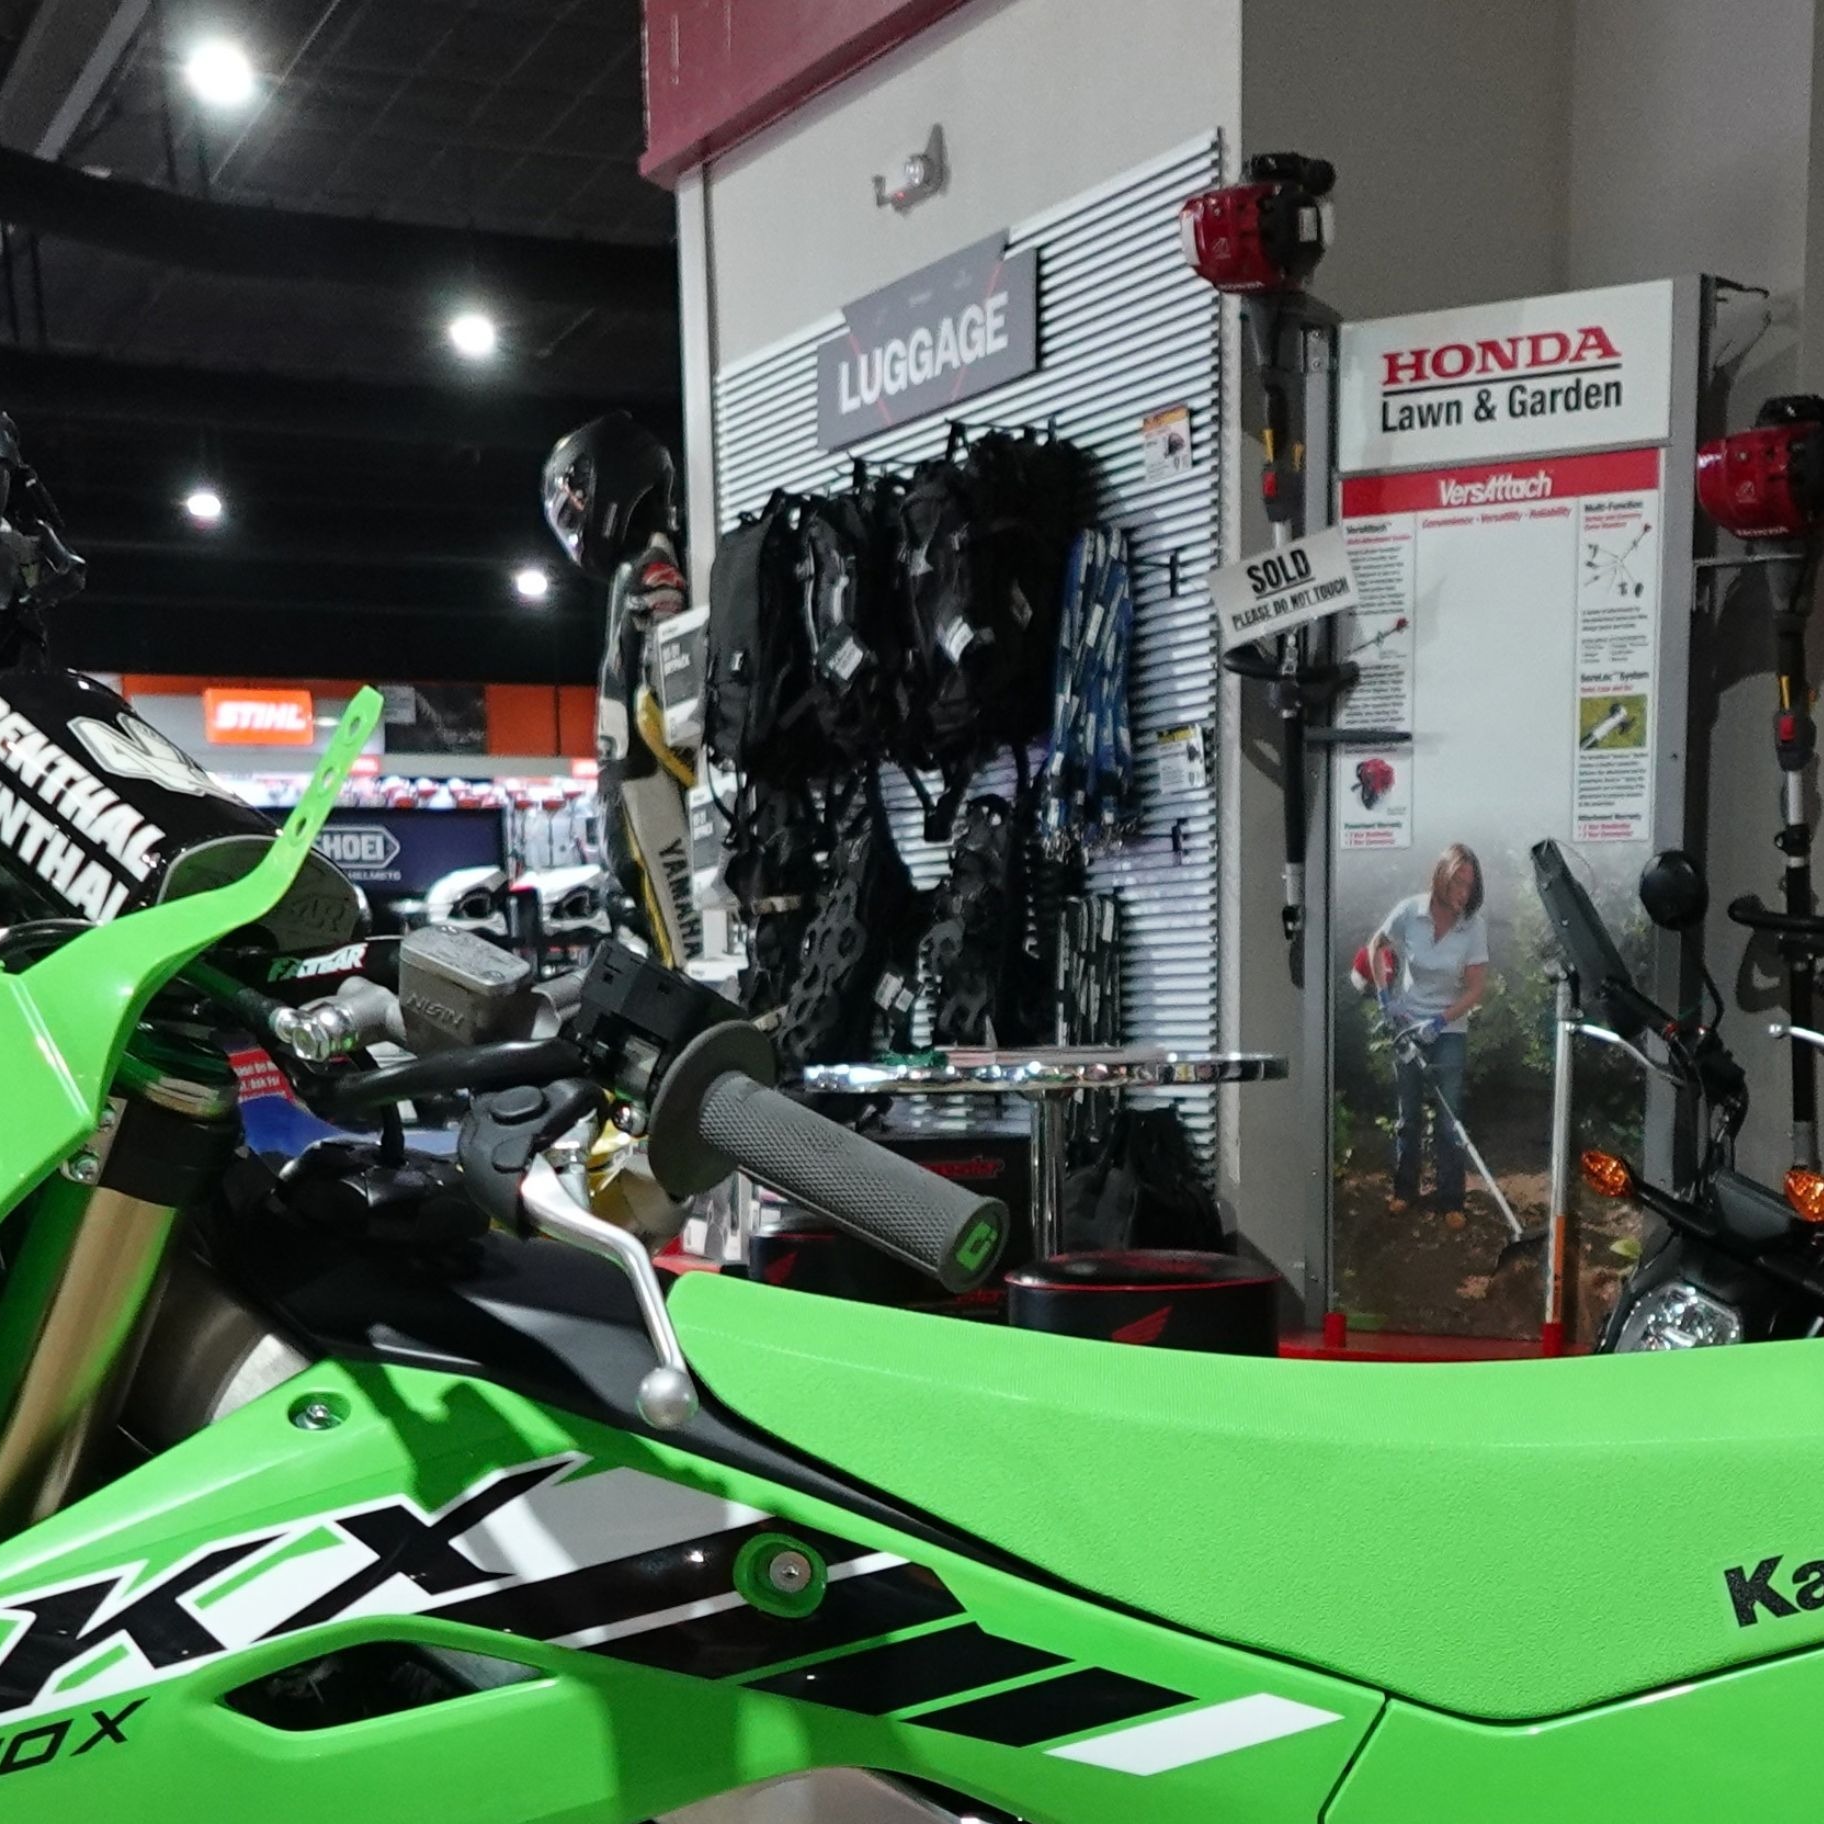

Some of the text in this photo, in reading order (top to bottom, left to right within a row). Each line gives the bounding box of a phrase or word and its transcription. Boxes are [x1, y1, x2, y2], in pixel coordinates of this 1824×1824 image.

[837, 291, 1009, 415] LUGGAGE
[1381, 326, 1622, 386] HONDA
[1382, 376, 1623, 433] Lawn & Garden
[1439, 469, 1553, 506] VersAttach
[1247, 549, 1311, 593] SOLD
[1232, 577, 1350, 632] PLEASE DO NOT TOUCH
[215, 702, 307, 731] STIHL
[313, 832, 386, 862] HOEI
[658, 837, 702, 960] YAMAHA
